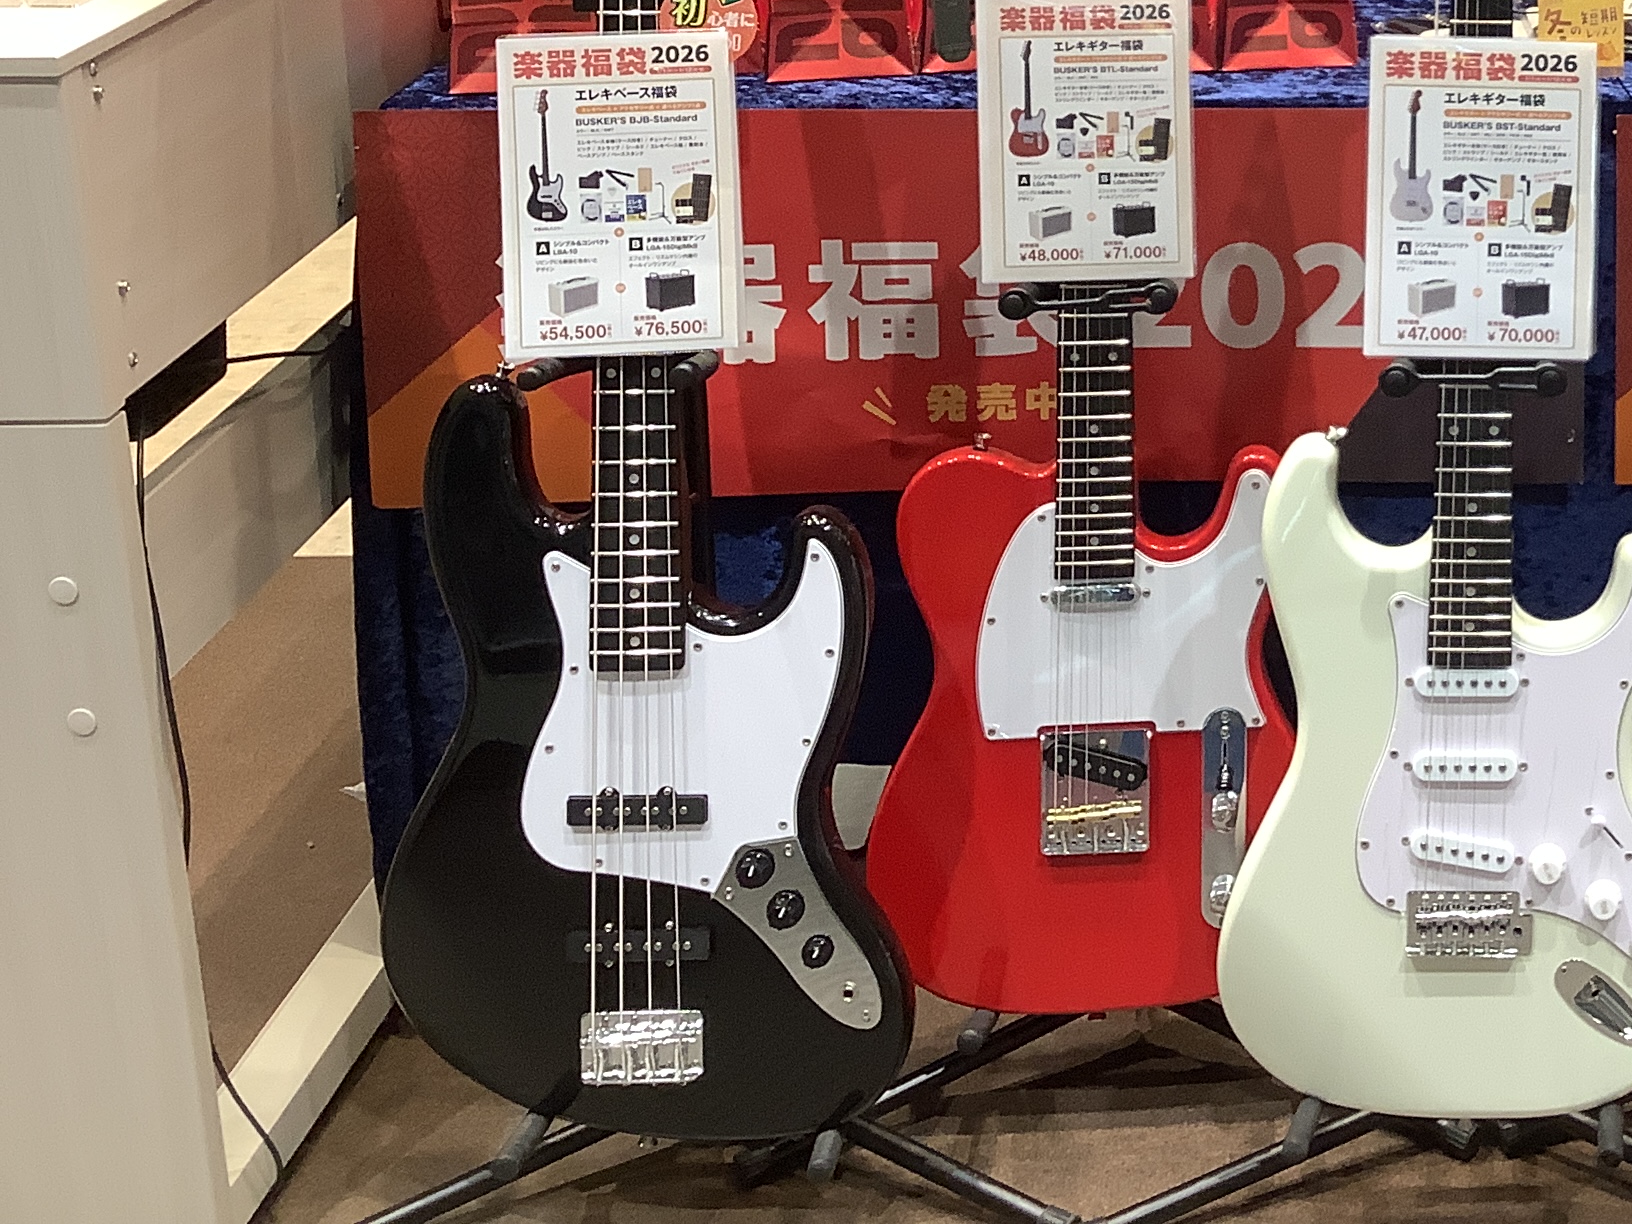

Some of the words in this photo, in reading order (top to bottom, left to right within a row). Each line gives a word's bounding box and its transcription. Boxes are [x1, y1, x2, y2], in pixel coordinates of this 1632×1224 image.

[1000, 4, 1117, 32] 楽器福袋
[1119, 3, 1171, 21] 2026
[1580, 6, 1618, 26] 短期
[1053, 39, 1144, 53] エレキギター福袋
[513, 47, 648, 79] 楽器福袋
[651, 45, 709, 64] 2026
[1386, 50, 1517, 82] 楽器福袋
[1520, 53, 1578, 73] 2026
[575, 86, 678, 101] エレキベース福袋
[1443, 92, 1546, 107] エレキギター福袋
[575, 116, 627, 127] BUSKER'S
[629, 114, 698, 125] BJB-Standard
[1443, 120, 1494, 130] BUSKER'S
[1019, 247, 1080, 262] ¥48,000
[1104, 245, 1163, 260] ¥71,000
[539, 324, 607, 341] ¥54,500
[634, 320, 703, 336] ¥76,500
[1397, 325, 1463, 342] ¥47,000
[1488, 327, 1556, 343] ¥70,000
